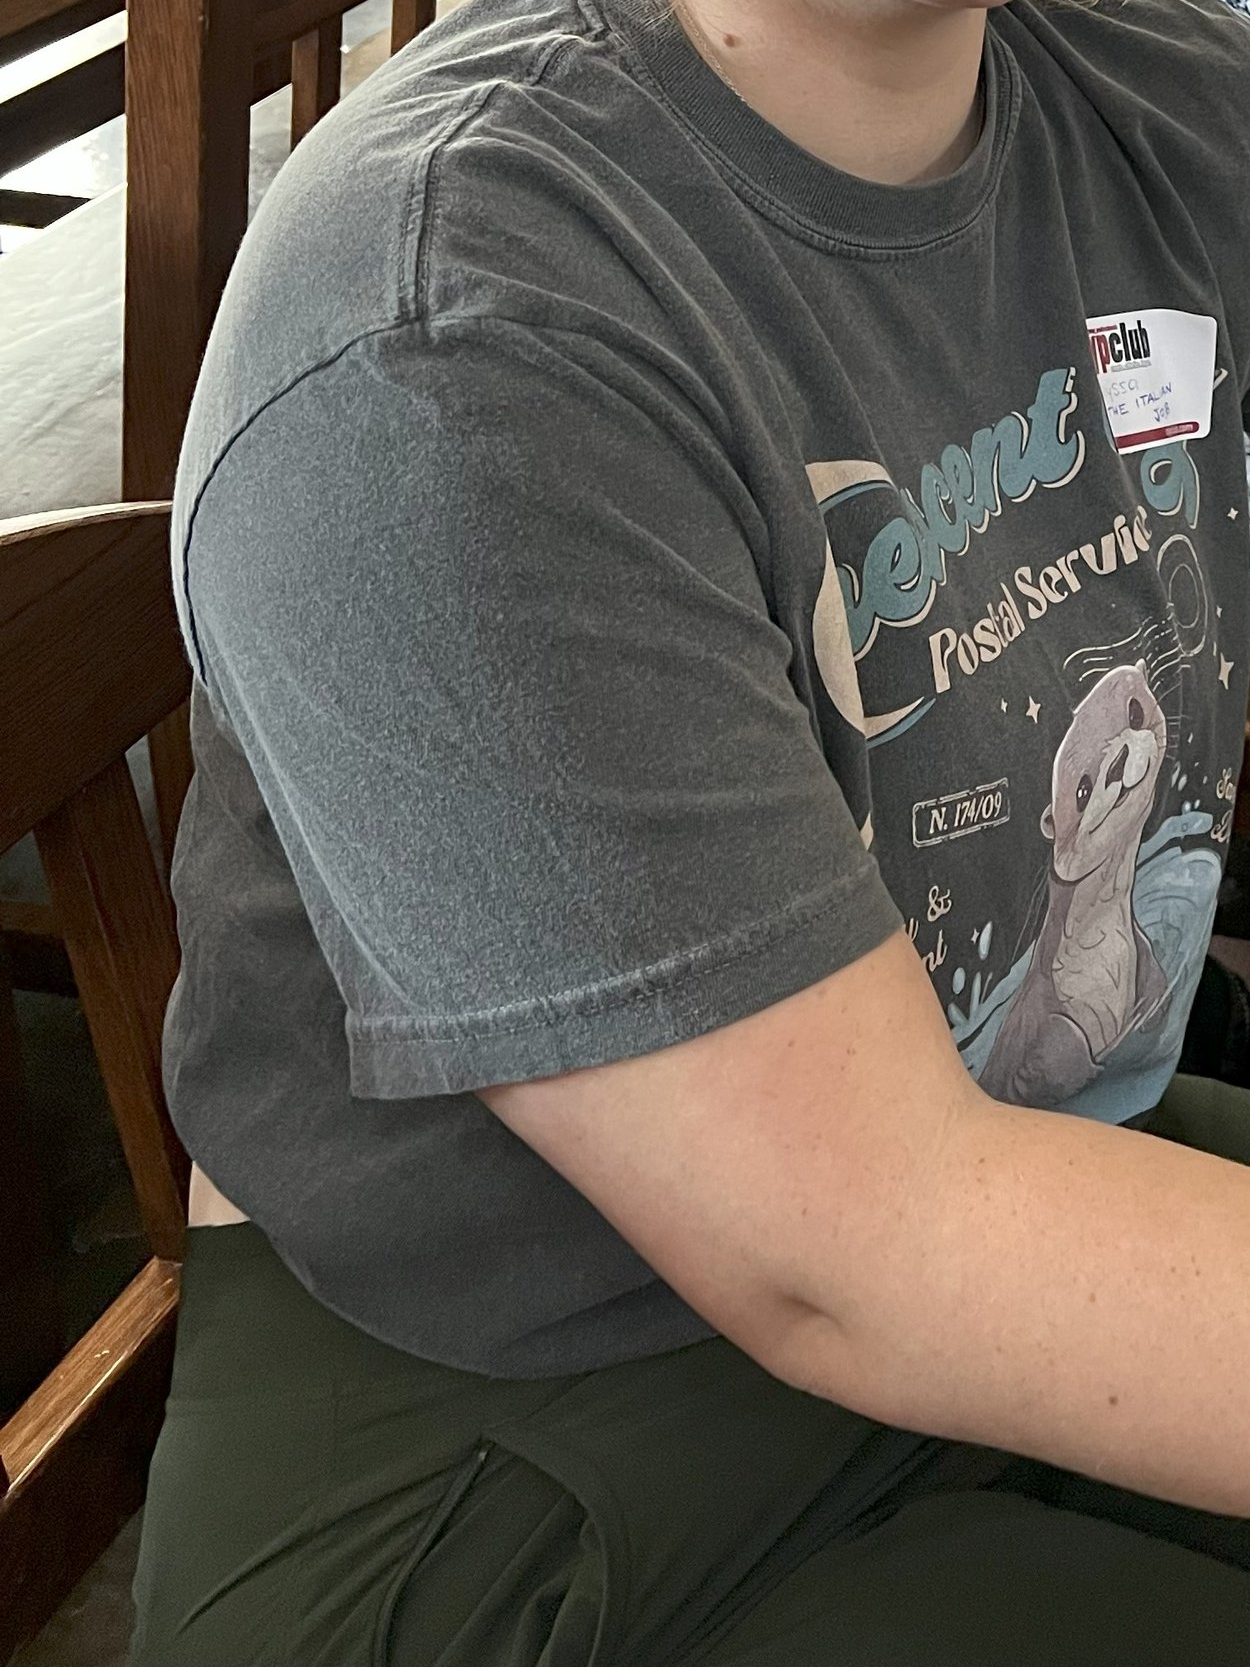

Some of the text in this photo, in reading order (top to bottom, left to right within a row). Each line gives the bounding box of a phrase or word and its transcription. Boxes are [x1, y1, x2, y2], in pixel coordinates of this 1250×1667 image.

[929, 582, 1026, 694] Postal
[929, 791, 1002, 834] N. 174/09
